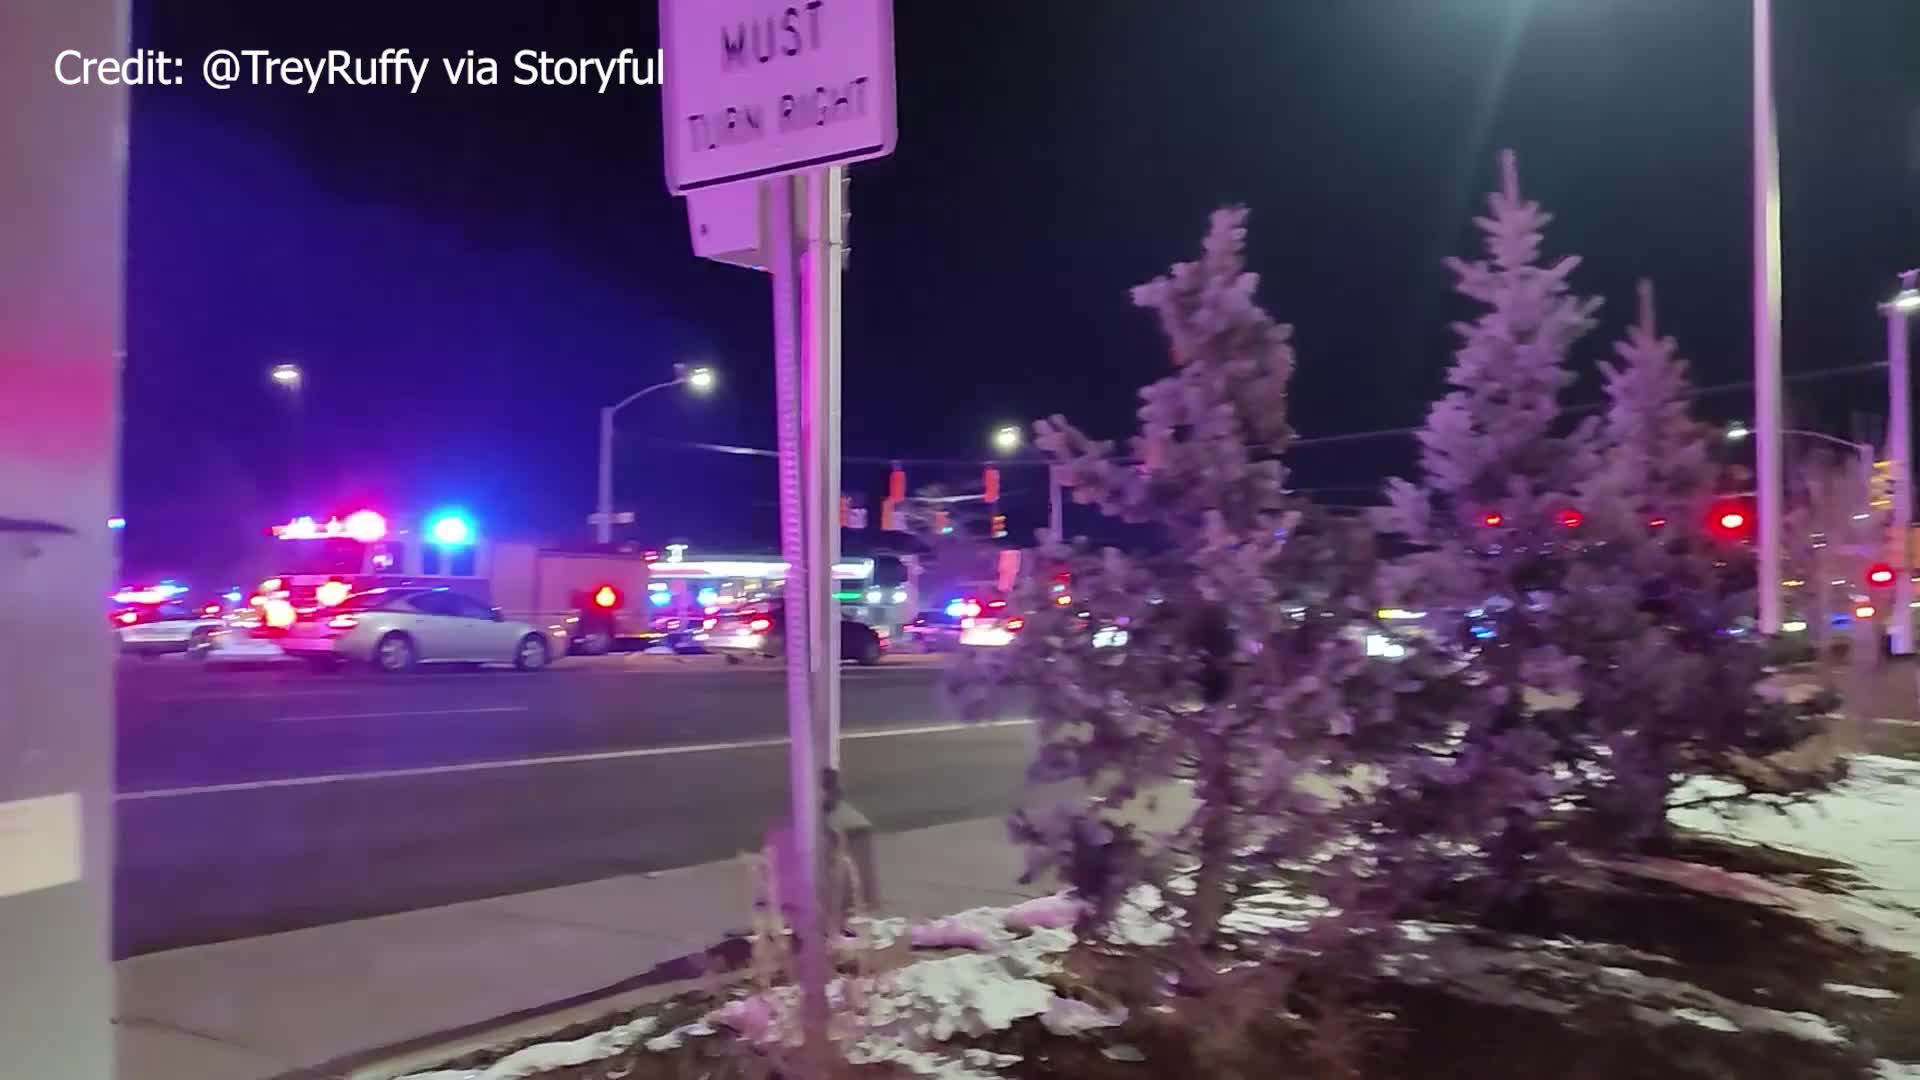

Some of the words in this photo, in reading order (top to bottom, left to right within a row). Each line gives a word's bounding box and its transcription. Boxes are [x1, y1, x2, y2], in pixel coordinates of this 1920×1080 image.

[721, 0, 823, 68] MUST
[687, 106, 765, 152] TURN
[778, 76, 869, 133] RIGHT
